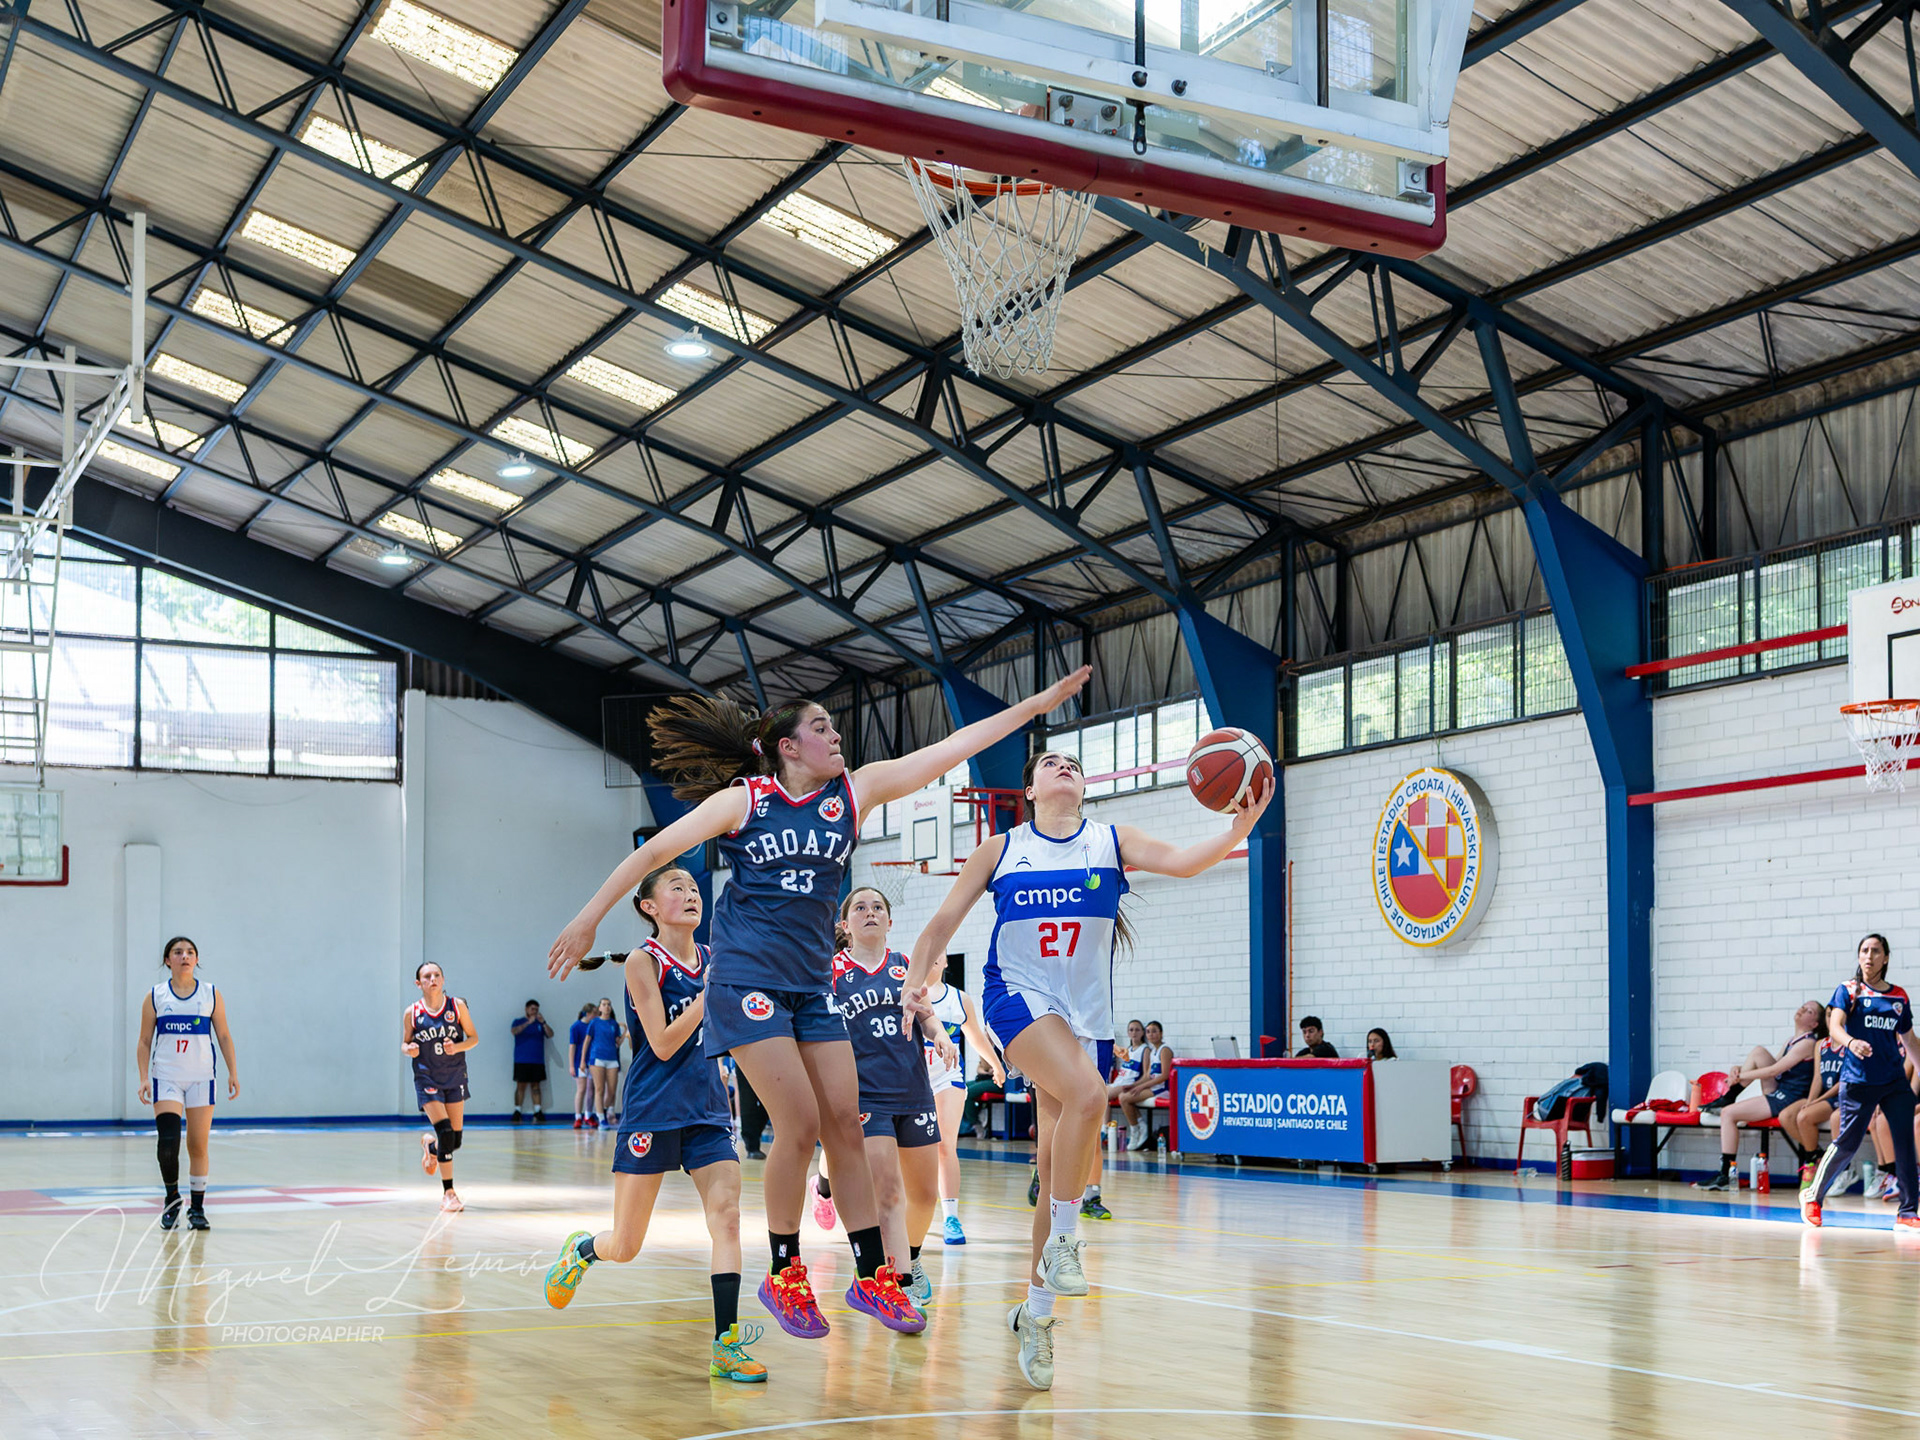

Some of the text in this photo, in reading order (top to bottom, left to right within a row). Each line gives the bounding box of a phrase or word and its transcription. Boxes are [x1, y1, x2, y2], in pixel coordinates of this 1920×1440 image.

[1378, 778, 1445, 854] ESTADIO CROATA
[744, 828, 851, 866] CROATA
[1450, 789, 1477, 907] HRVATSKI KLUB
[780, 869, 816, 894] 23
[1014, 887, 1082, 908] cmpc
[1377, 866, 1457, 939] SANTIAGO DE CHILE
[1038, 921, 1081, 957] 27
[165, 1022, 192, 1033] cmpc
[870, 1015, 898, 1038] 36
[176, 1039, 189, 1053] 17
[1223, 1093, 1348, 1116] ESTADIO CROATA
[1223, 1116, 1348, 1131] HRVATSKI KLUB SANTIAGO DE CHILE
